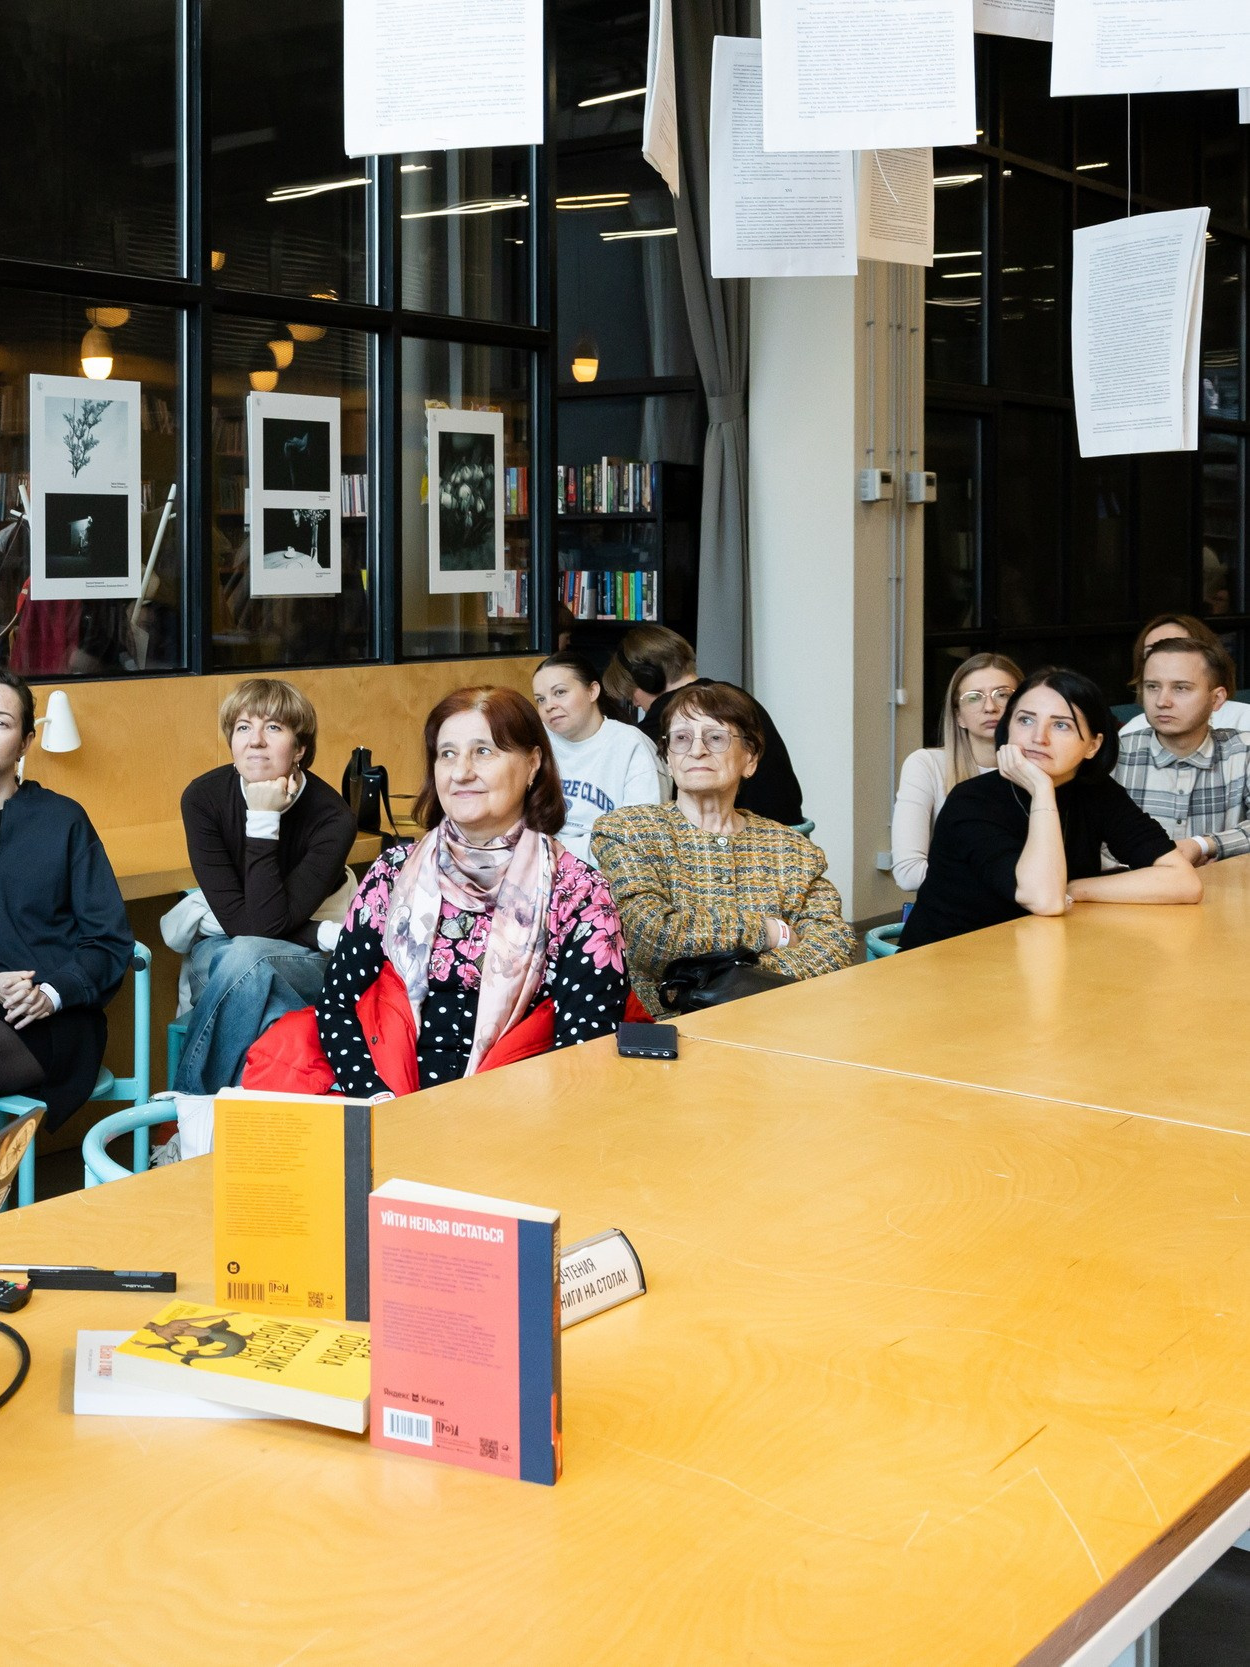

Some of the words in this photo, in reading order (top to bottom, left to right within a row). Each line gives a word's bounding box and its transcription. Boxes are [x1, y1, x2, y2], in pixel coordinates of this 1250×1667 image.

[561, 779, 581, 797] RE
[581, 782, 615, 814] CLUB
[380, 1209, 408, 1229] УЙТИ
[409, 1215, 450, 1235] НЕЛЬЗЯ
[452, 1221, 504, 1244] ОСТАТЬСЯ
[560, 1257, 597, 1285] ОЧТЕНИЯ
[560, 1287, 584, 1310] НИГИ
[583, 1282, 597, 1300] НА
[233, 1320, 292, 1362] МОНСТРЫ
[254, 1325, 320, 1373] ПИТЕРСКИЕ
[315, 1334, 366, 1367] СОРОКА
[383, 1388, 410, 1401] Яндекс
[421, 1395, 445, 1407] Книги
